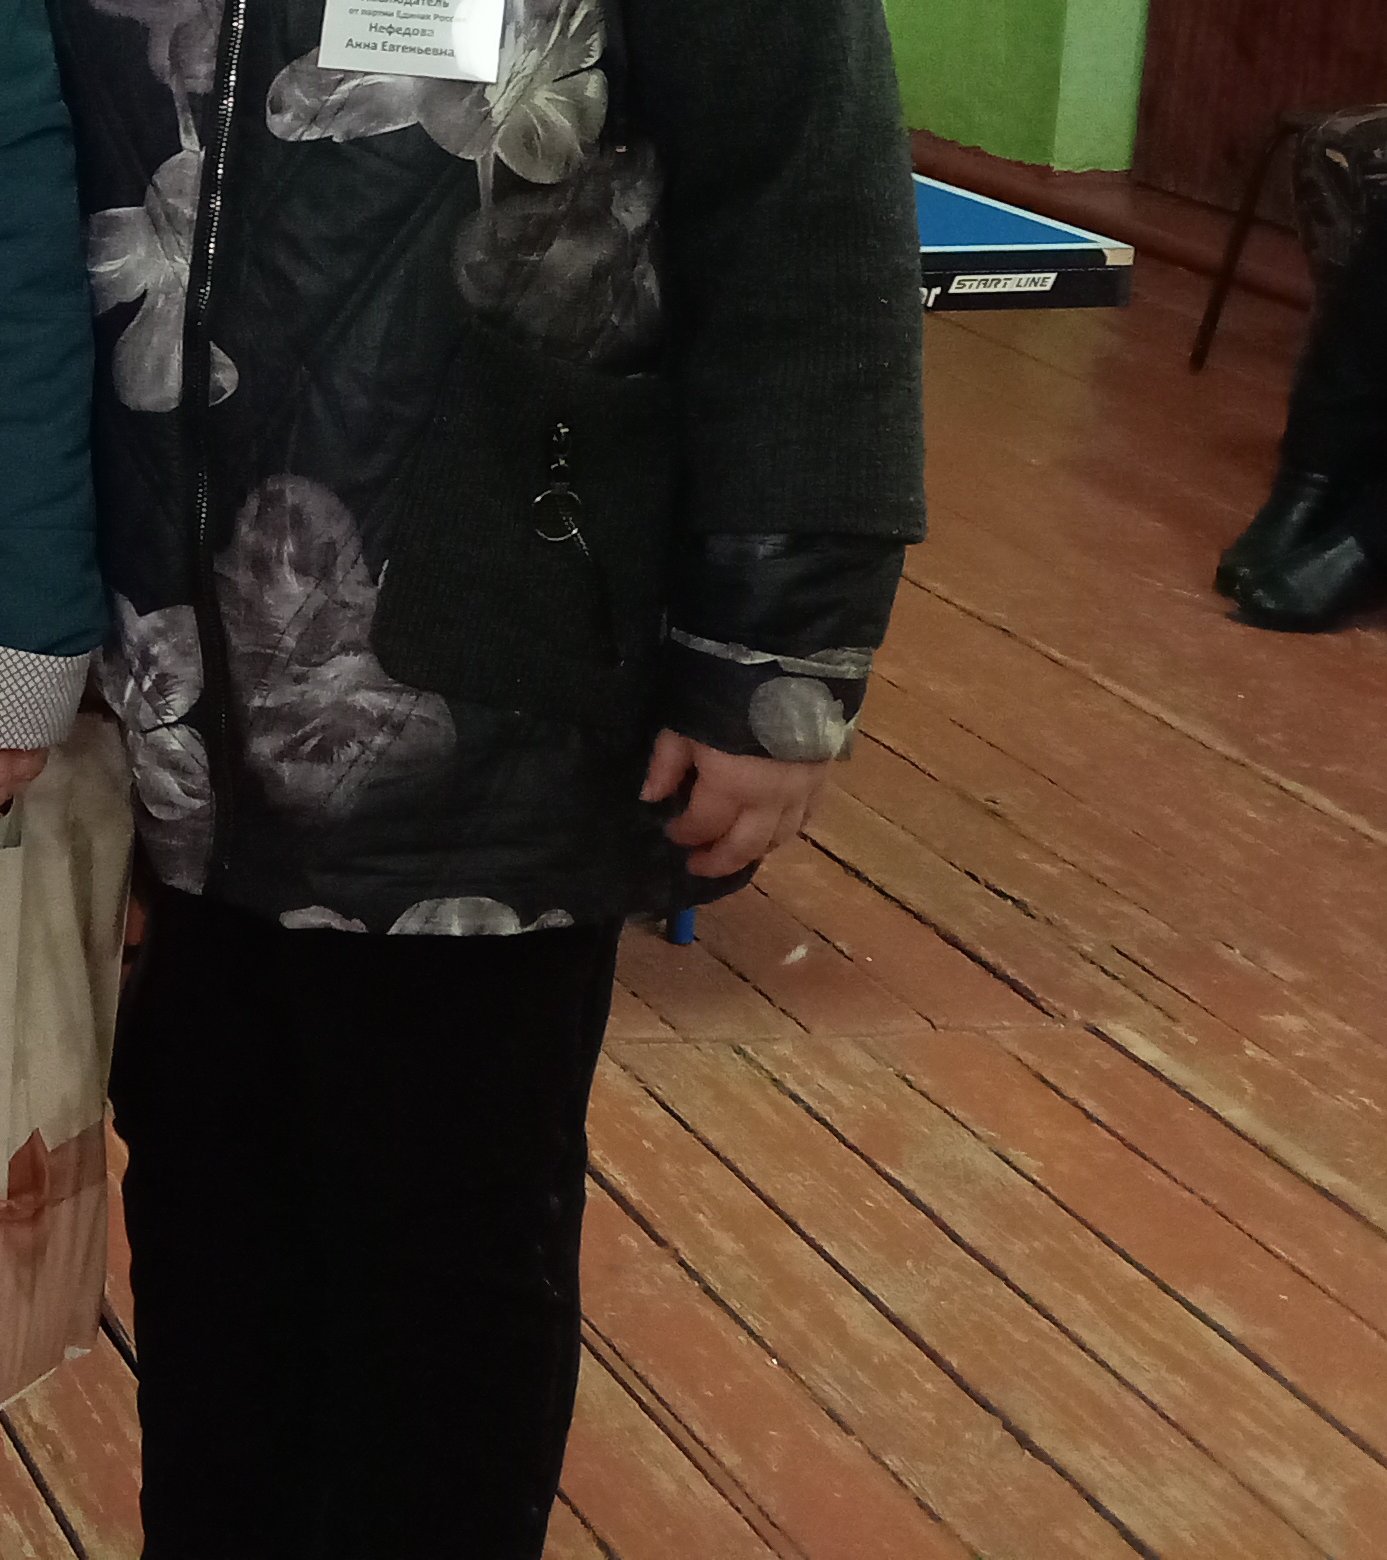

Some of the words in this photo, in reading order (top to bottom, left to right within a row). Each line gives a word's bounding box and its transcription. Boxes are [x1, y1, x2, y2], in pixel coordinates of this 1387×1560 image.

[433, 13, 467, 24] Росс
[368, 22, 435, 38] Нефедова
[345, 37, 378, 52] Анна
[381, 40, 456, 58] Евгеньевна
[955, 277, 1012, 290] START
[1015, 276, 1052, 288] LINE
